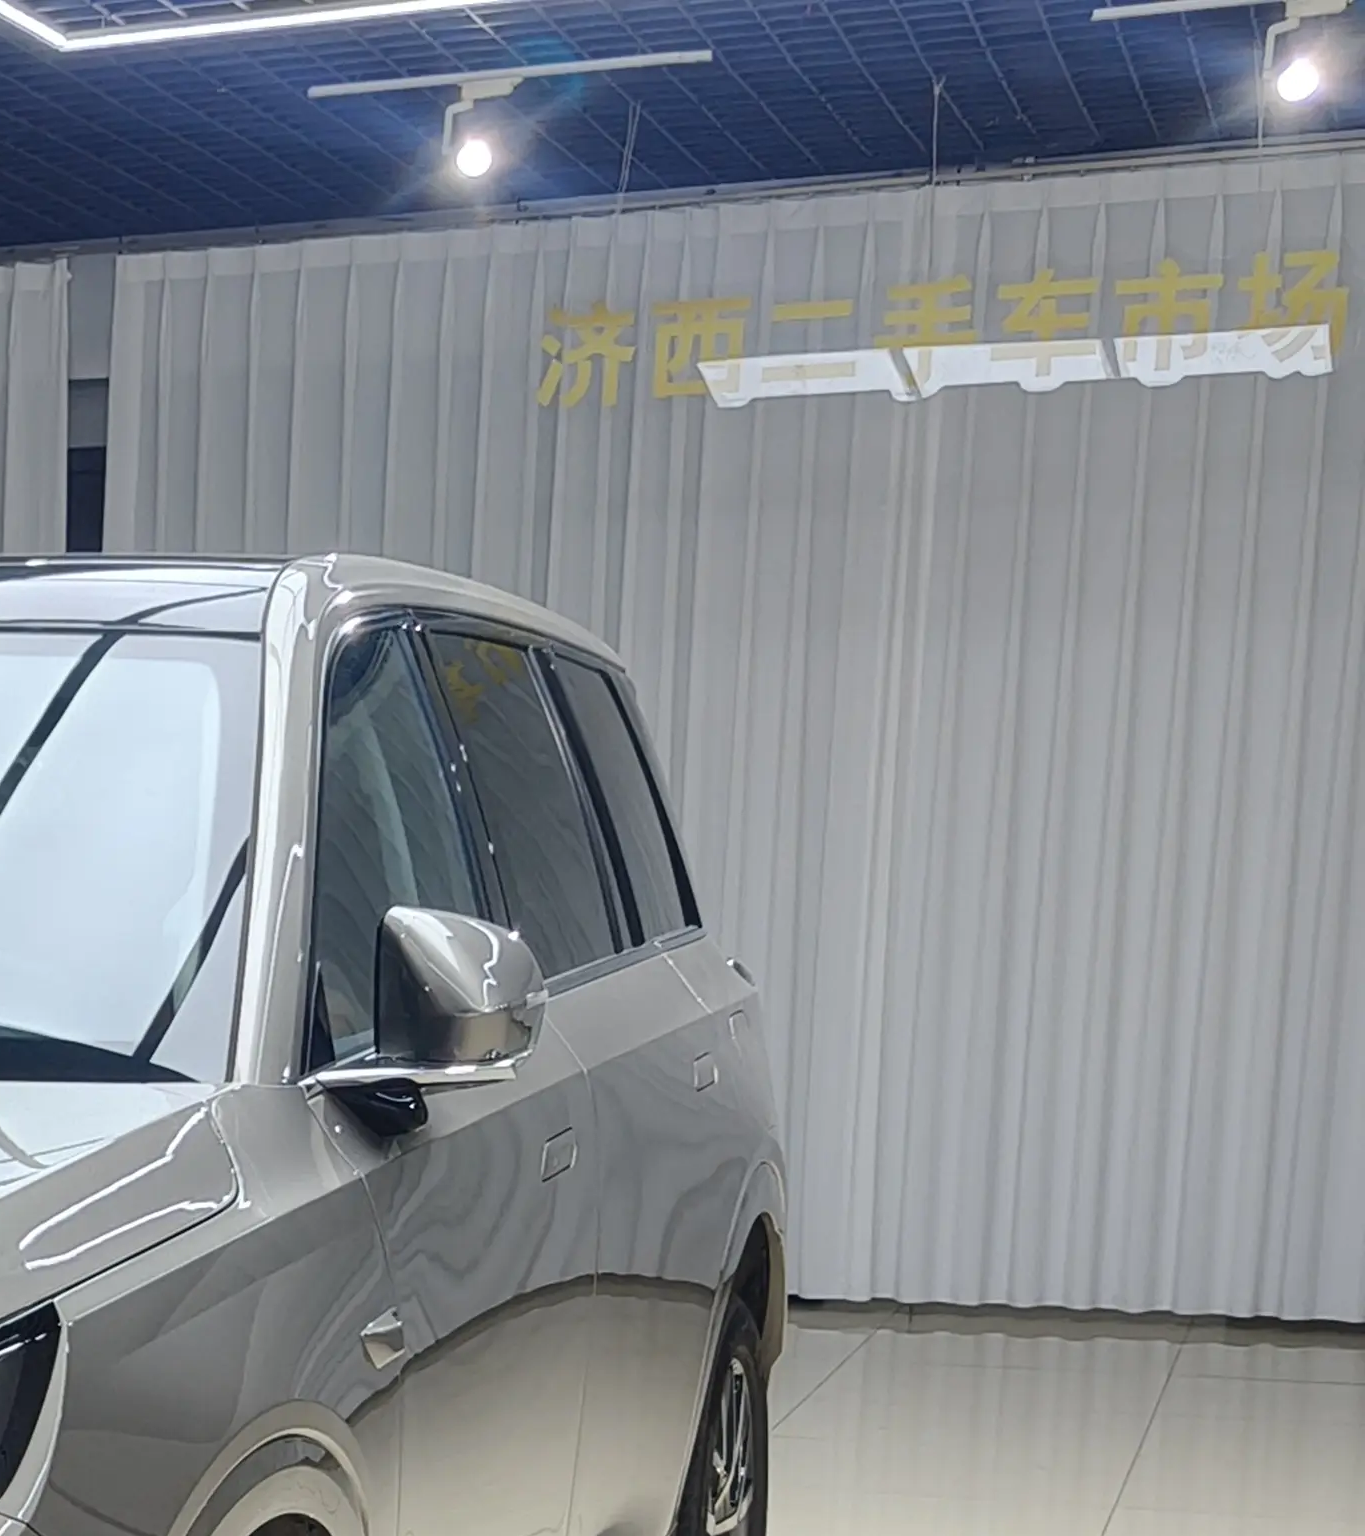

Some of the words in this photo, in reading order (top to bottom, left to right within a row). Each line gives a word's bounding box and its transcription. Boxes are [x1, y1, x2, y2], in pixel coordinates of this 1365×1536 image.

[537, 249, 1349, 409] 济西二手车市场
